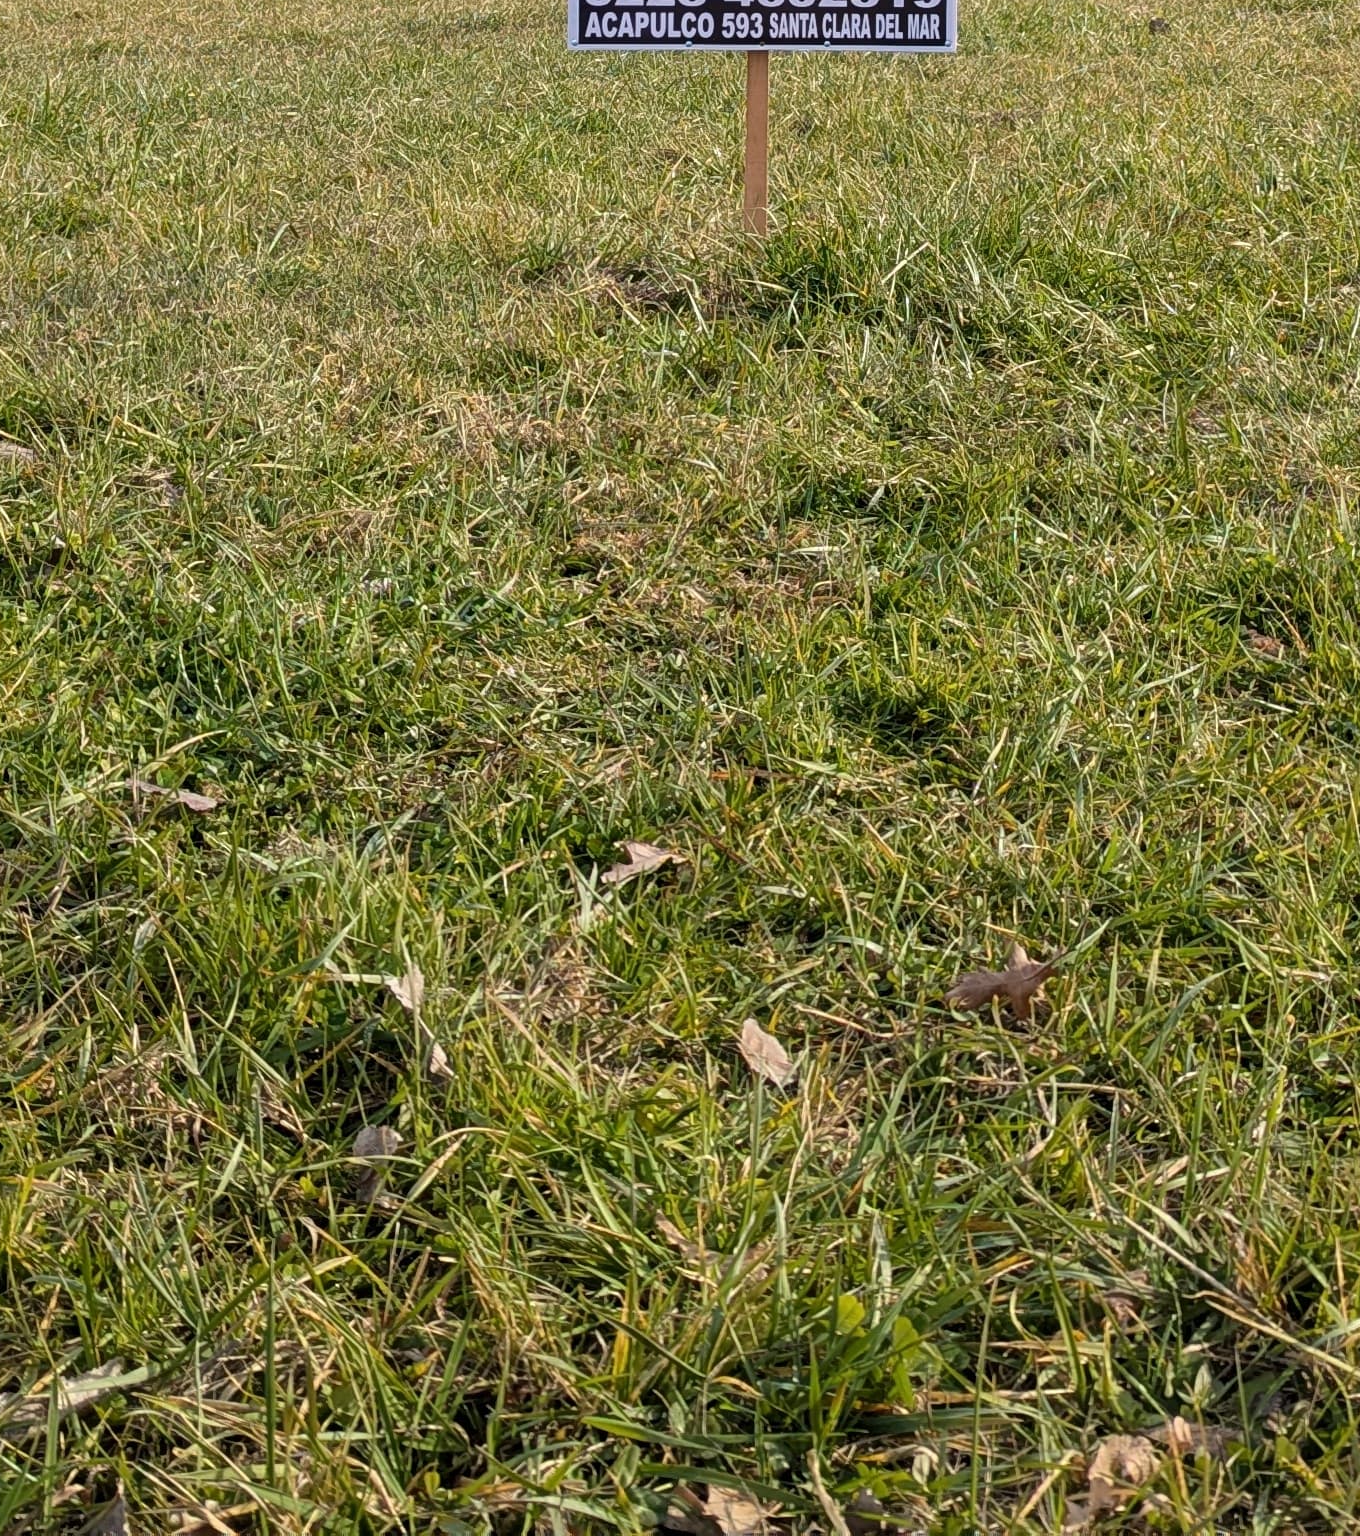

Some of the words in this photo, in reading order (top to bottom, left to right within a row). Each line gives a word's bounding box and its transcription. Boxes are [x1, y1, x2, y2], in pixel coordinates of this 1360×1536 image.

[585, 12, 714, 39] ACAPULCO
[722, 12, 764, 39] 593
[769, 13, 818, 39] SANTA
[822, 13, 872, 39] CLARA
[875, 13, 903, 39] DEL
[907, 14, 940, 40] MAR
